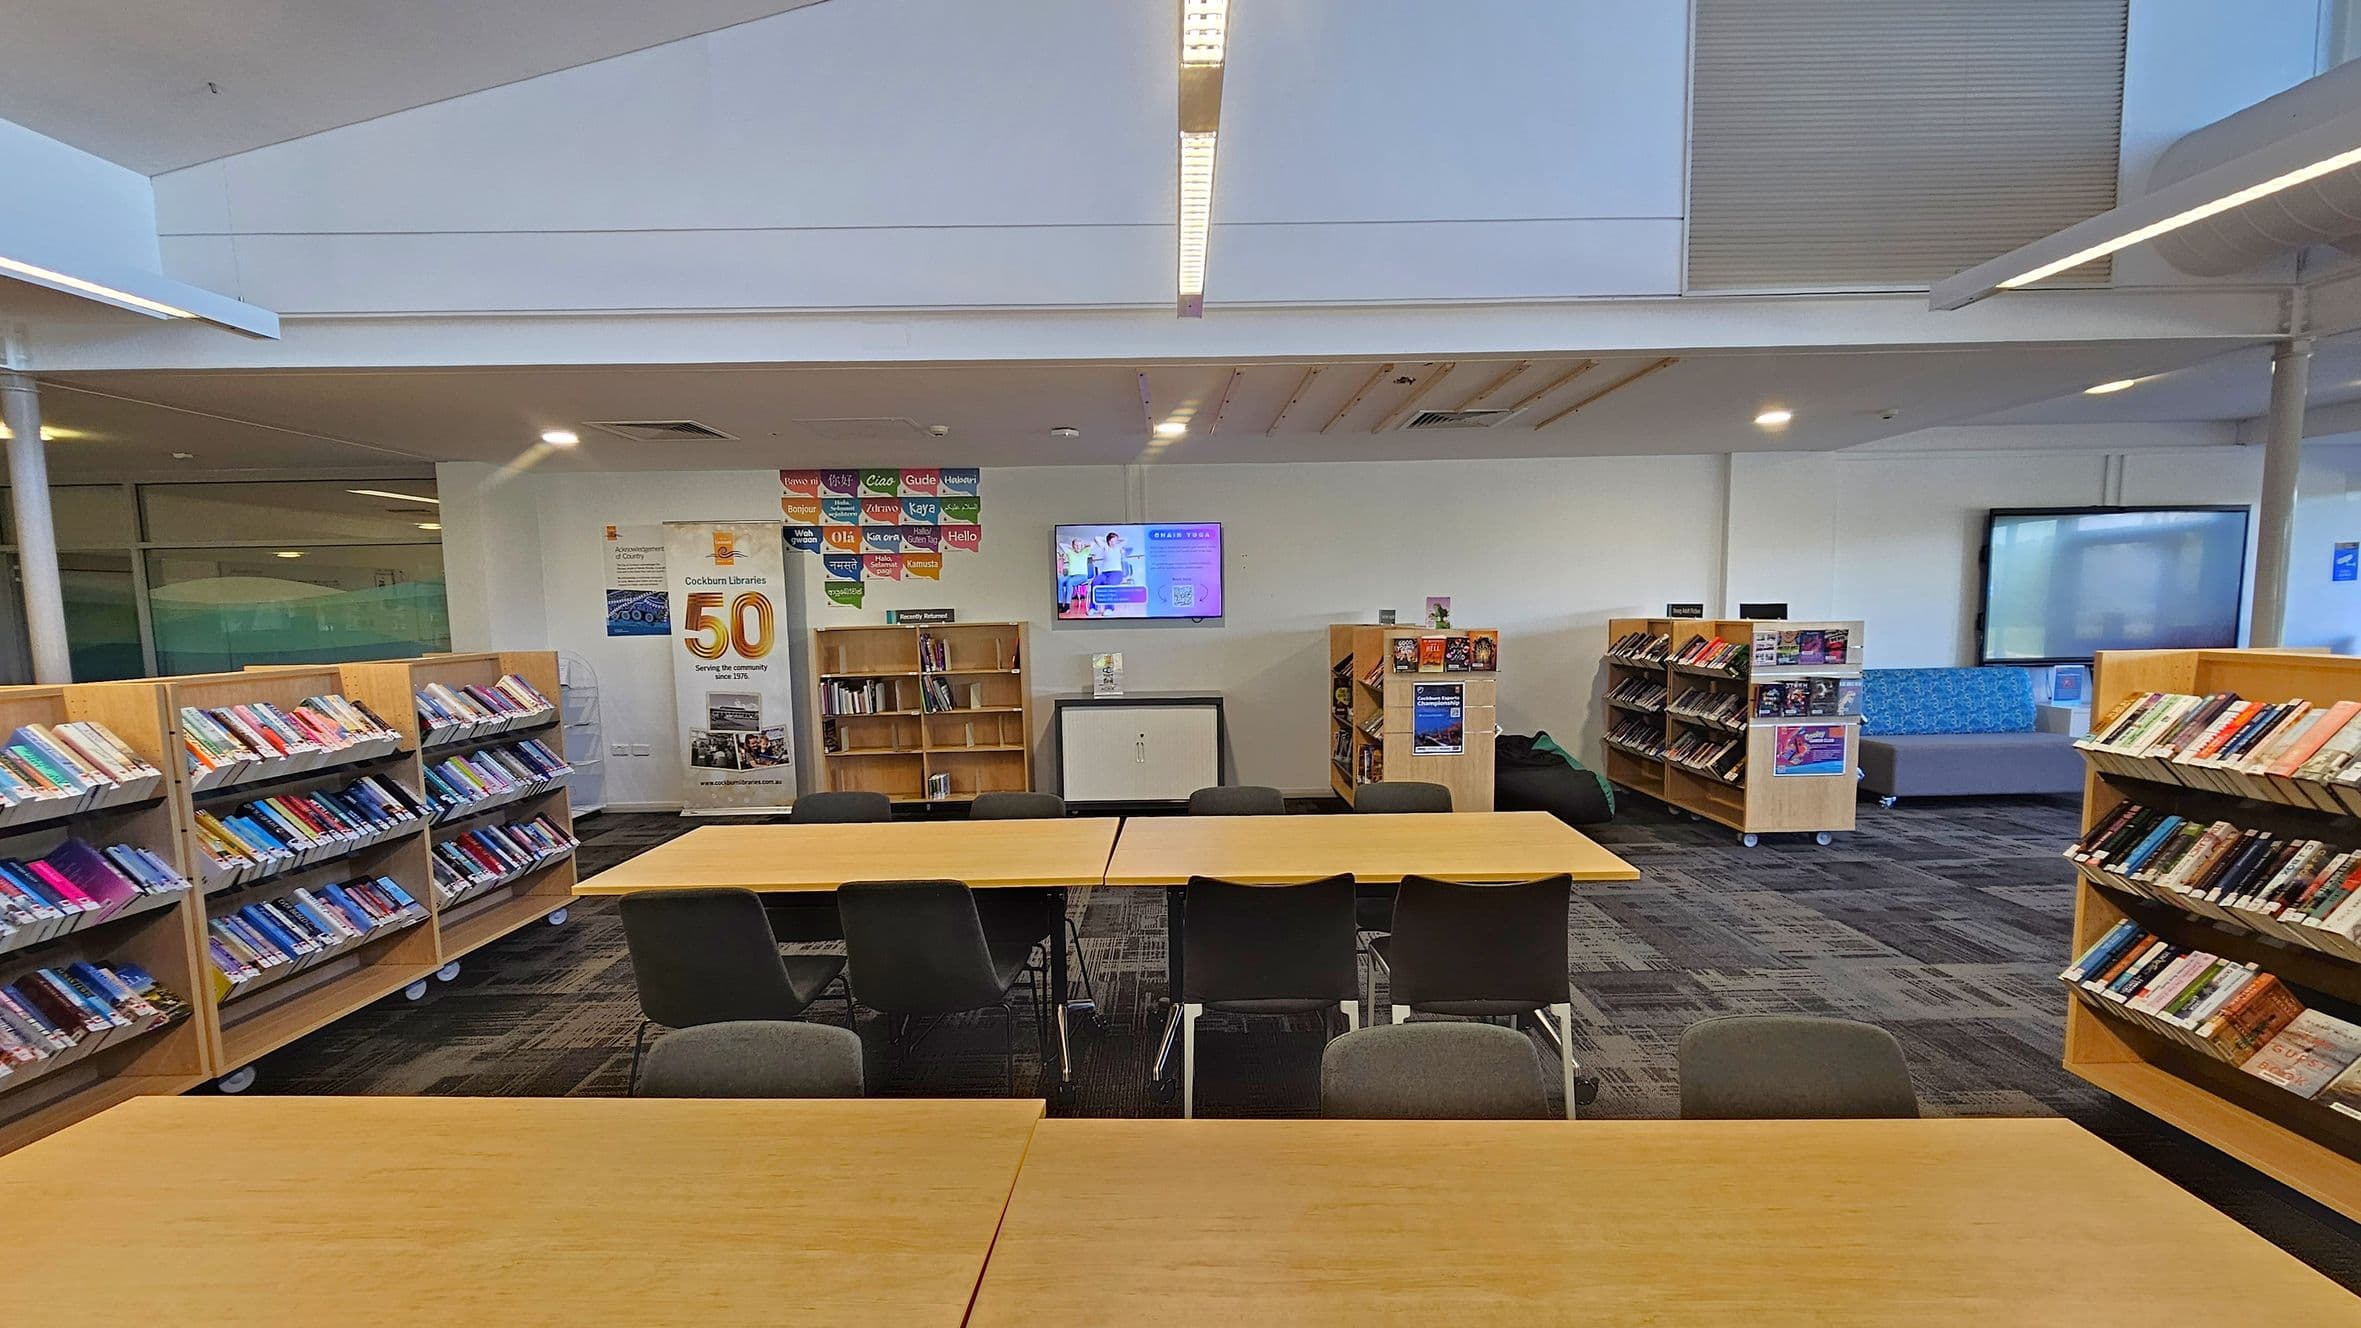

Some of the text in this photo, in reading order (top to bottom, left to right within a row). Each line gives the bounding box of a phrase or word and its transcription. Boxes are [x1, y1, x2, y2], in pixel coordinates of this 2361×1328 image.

[810, 477, 818, 485] ni
[829, 474, 853, 487] 你好
[866, 474, 895, 486] Ciao
[906, 474, 936, 485] Gude
[944, 474, 976, 484] Habari
[788, 505, 816, 514] Bonjour
[866, 504, 898, 512] Zdravo
[909, 502, 935, 516] Kaya
[832, 531, 854, 543] Olá
[866, 532, 882, 541] Kia
[908, 535, 937, 545] Guten Tag
[948, 531, 977, 541] Hello
[829, 558, 858, 572] नमस्ते
[907, 560, 938, 568] Kamusta
[877, 568, 892, 576] pagi
[685, 576, 767, 585] Cockburn Libraries
[685, 591, 774, 660] 50
